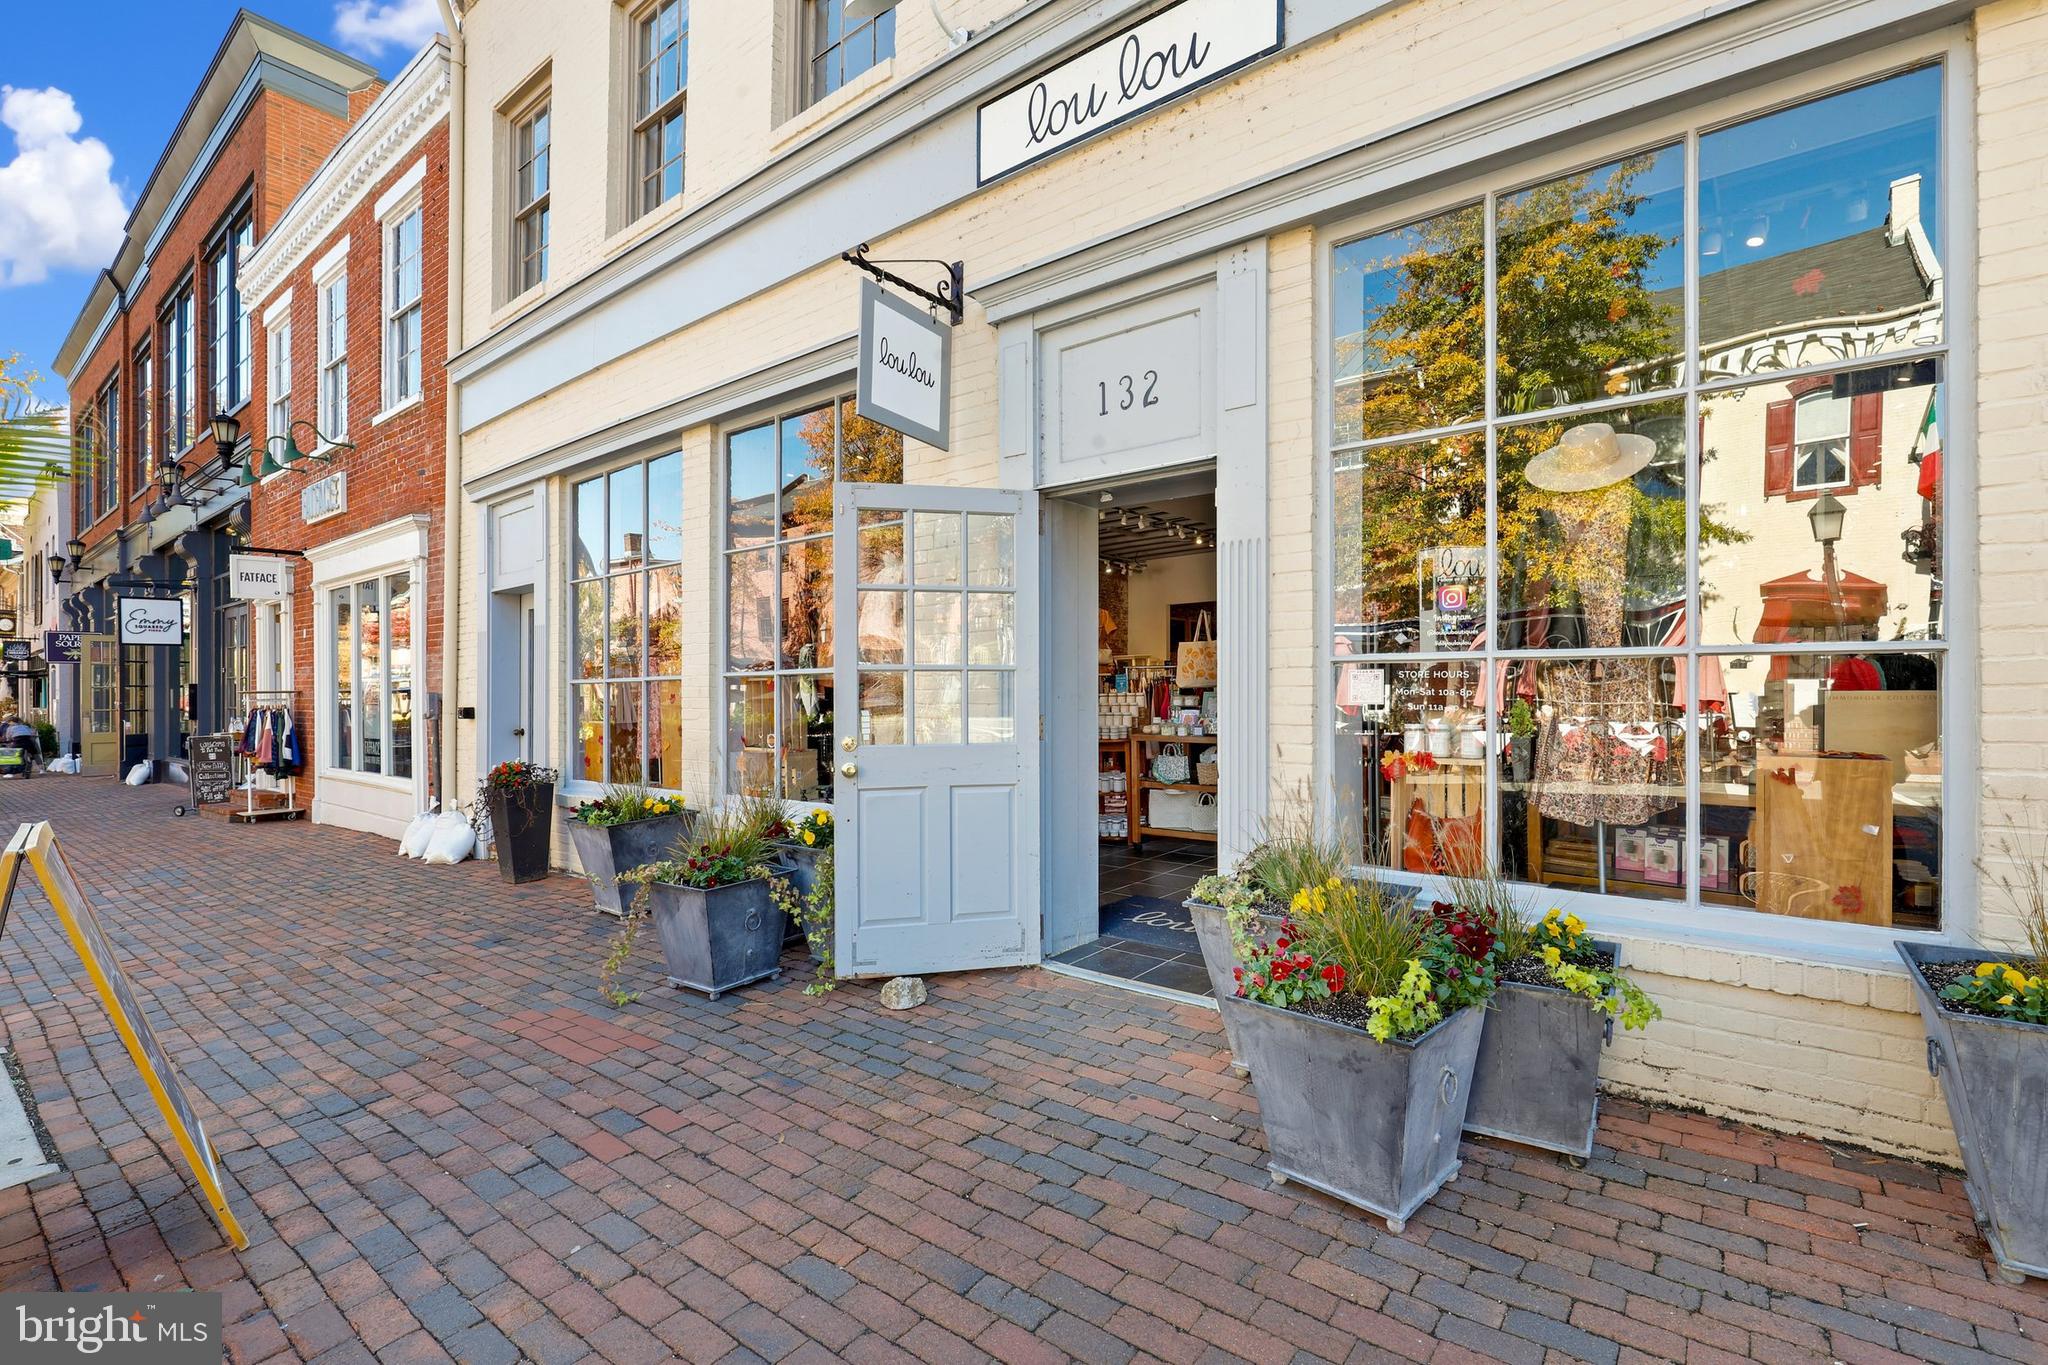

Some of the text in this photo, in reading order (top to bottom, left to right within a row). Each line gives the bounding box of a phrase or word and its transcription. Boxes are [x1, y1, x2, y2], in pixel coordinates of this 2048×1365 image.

[1025, 32, 1211, 148] lou lou
[1098, 369, 1160, 417] 132
[240, 571, 278, 583] FATFACE
[124, 608, 178, 635] Emmy
[1398, 670, 1470, 679] STORE HOURS
[1395, 687, 1473, 698] Mon-Sat 10a-8p
[1407, 703, 1425, 711] Sun
